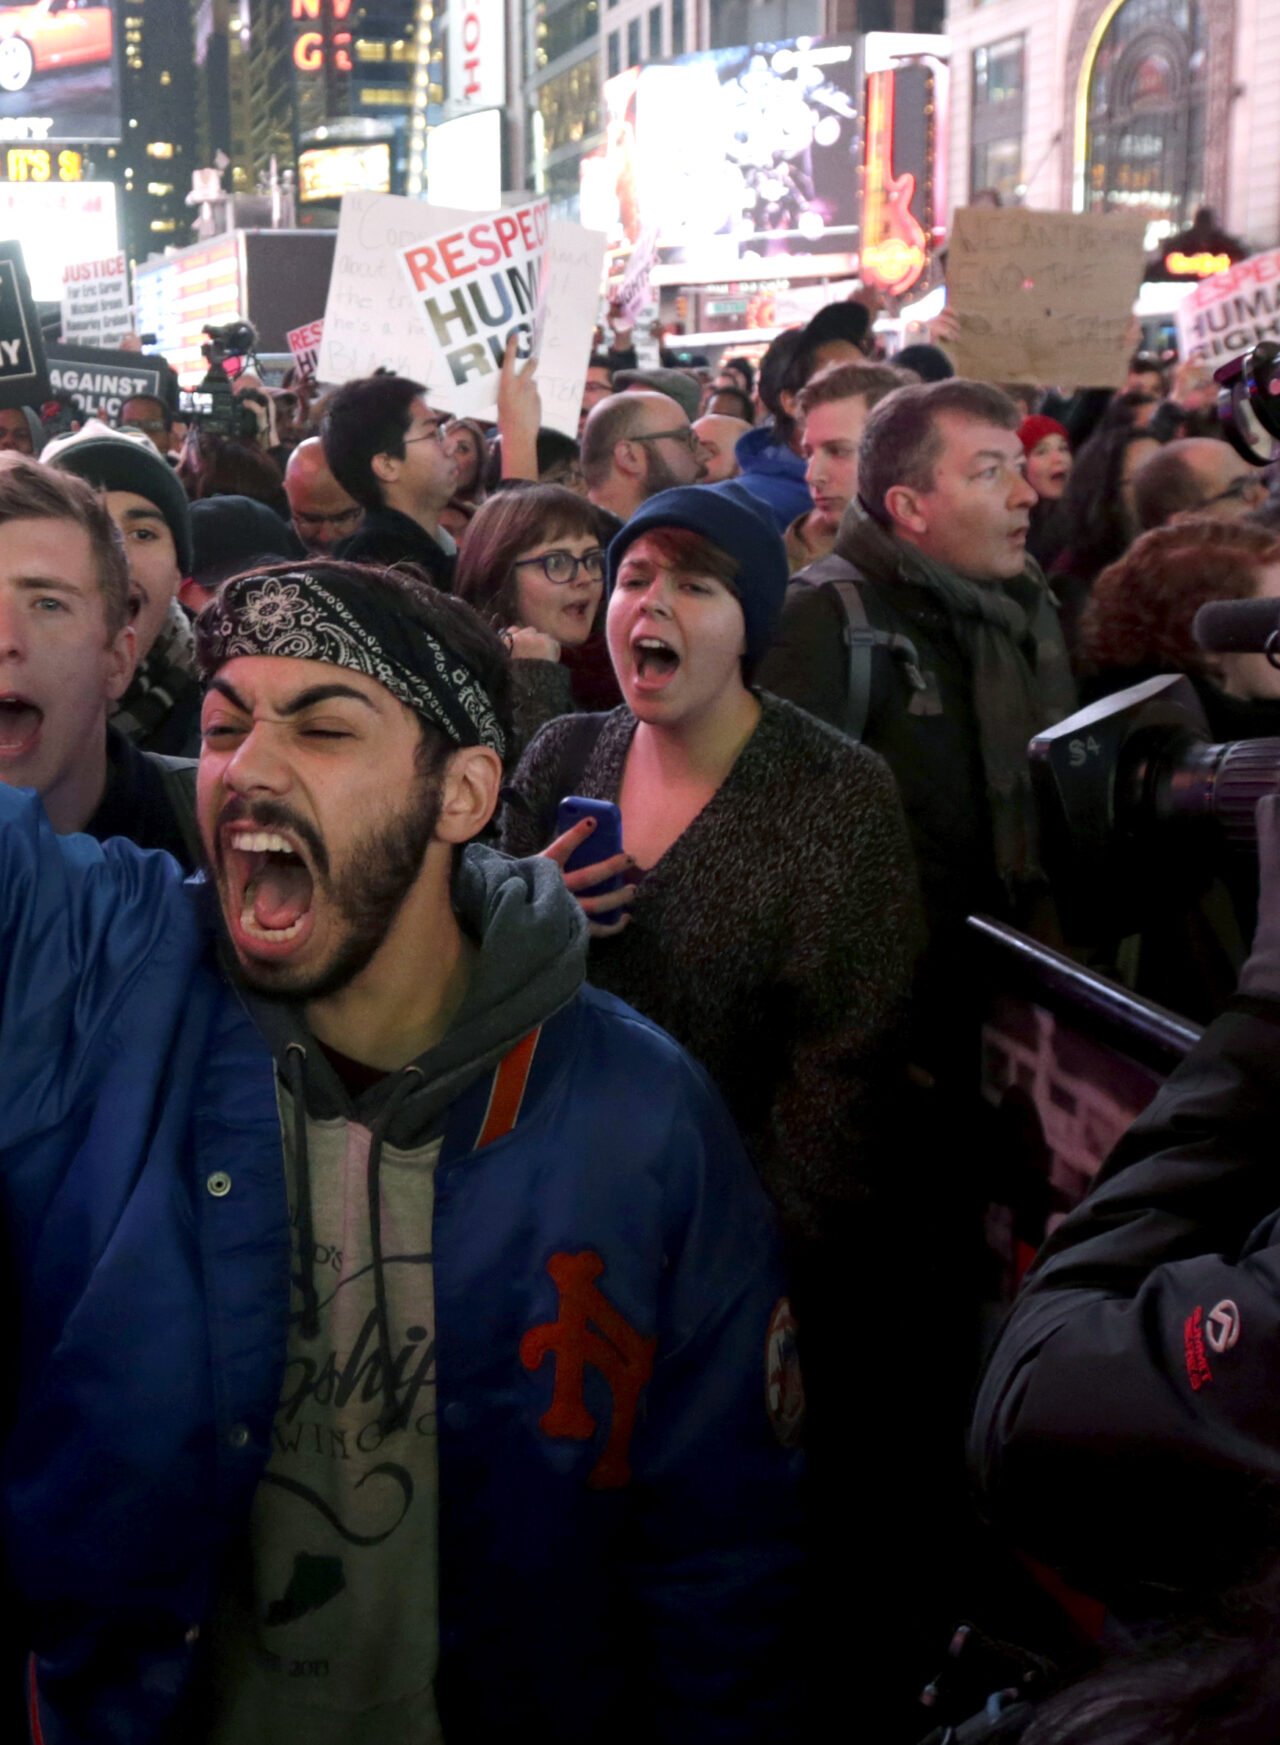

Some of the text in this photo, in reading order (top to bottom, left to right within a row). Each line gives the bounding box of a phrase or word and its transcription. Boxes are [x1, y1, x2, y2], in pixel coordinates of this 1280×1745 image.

[62, 256, 125, 283] JUSTICE
[424, 254, 545, 348] HUM
[290, 320, 323, 350] RES
[49, 369, 148, 396] AGAINST
[276, 1417, 386, 1461] WING
